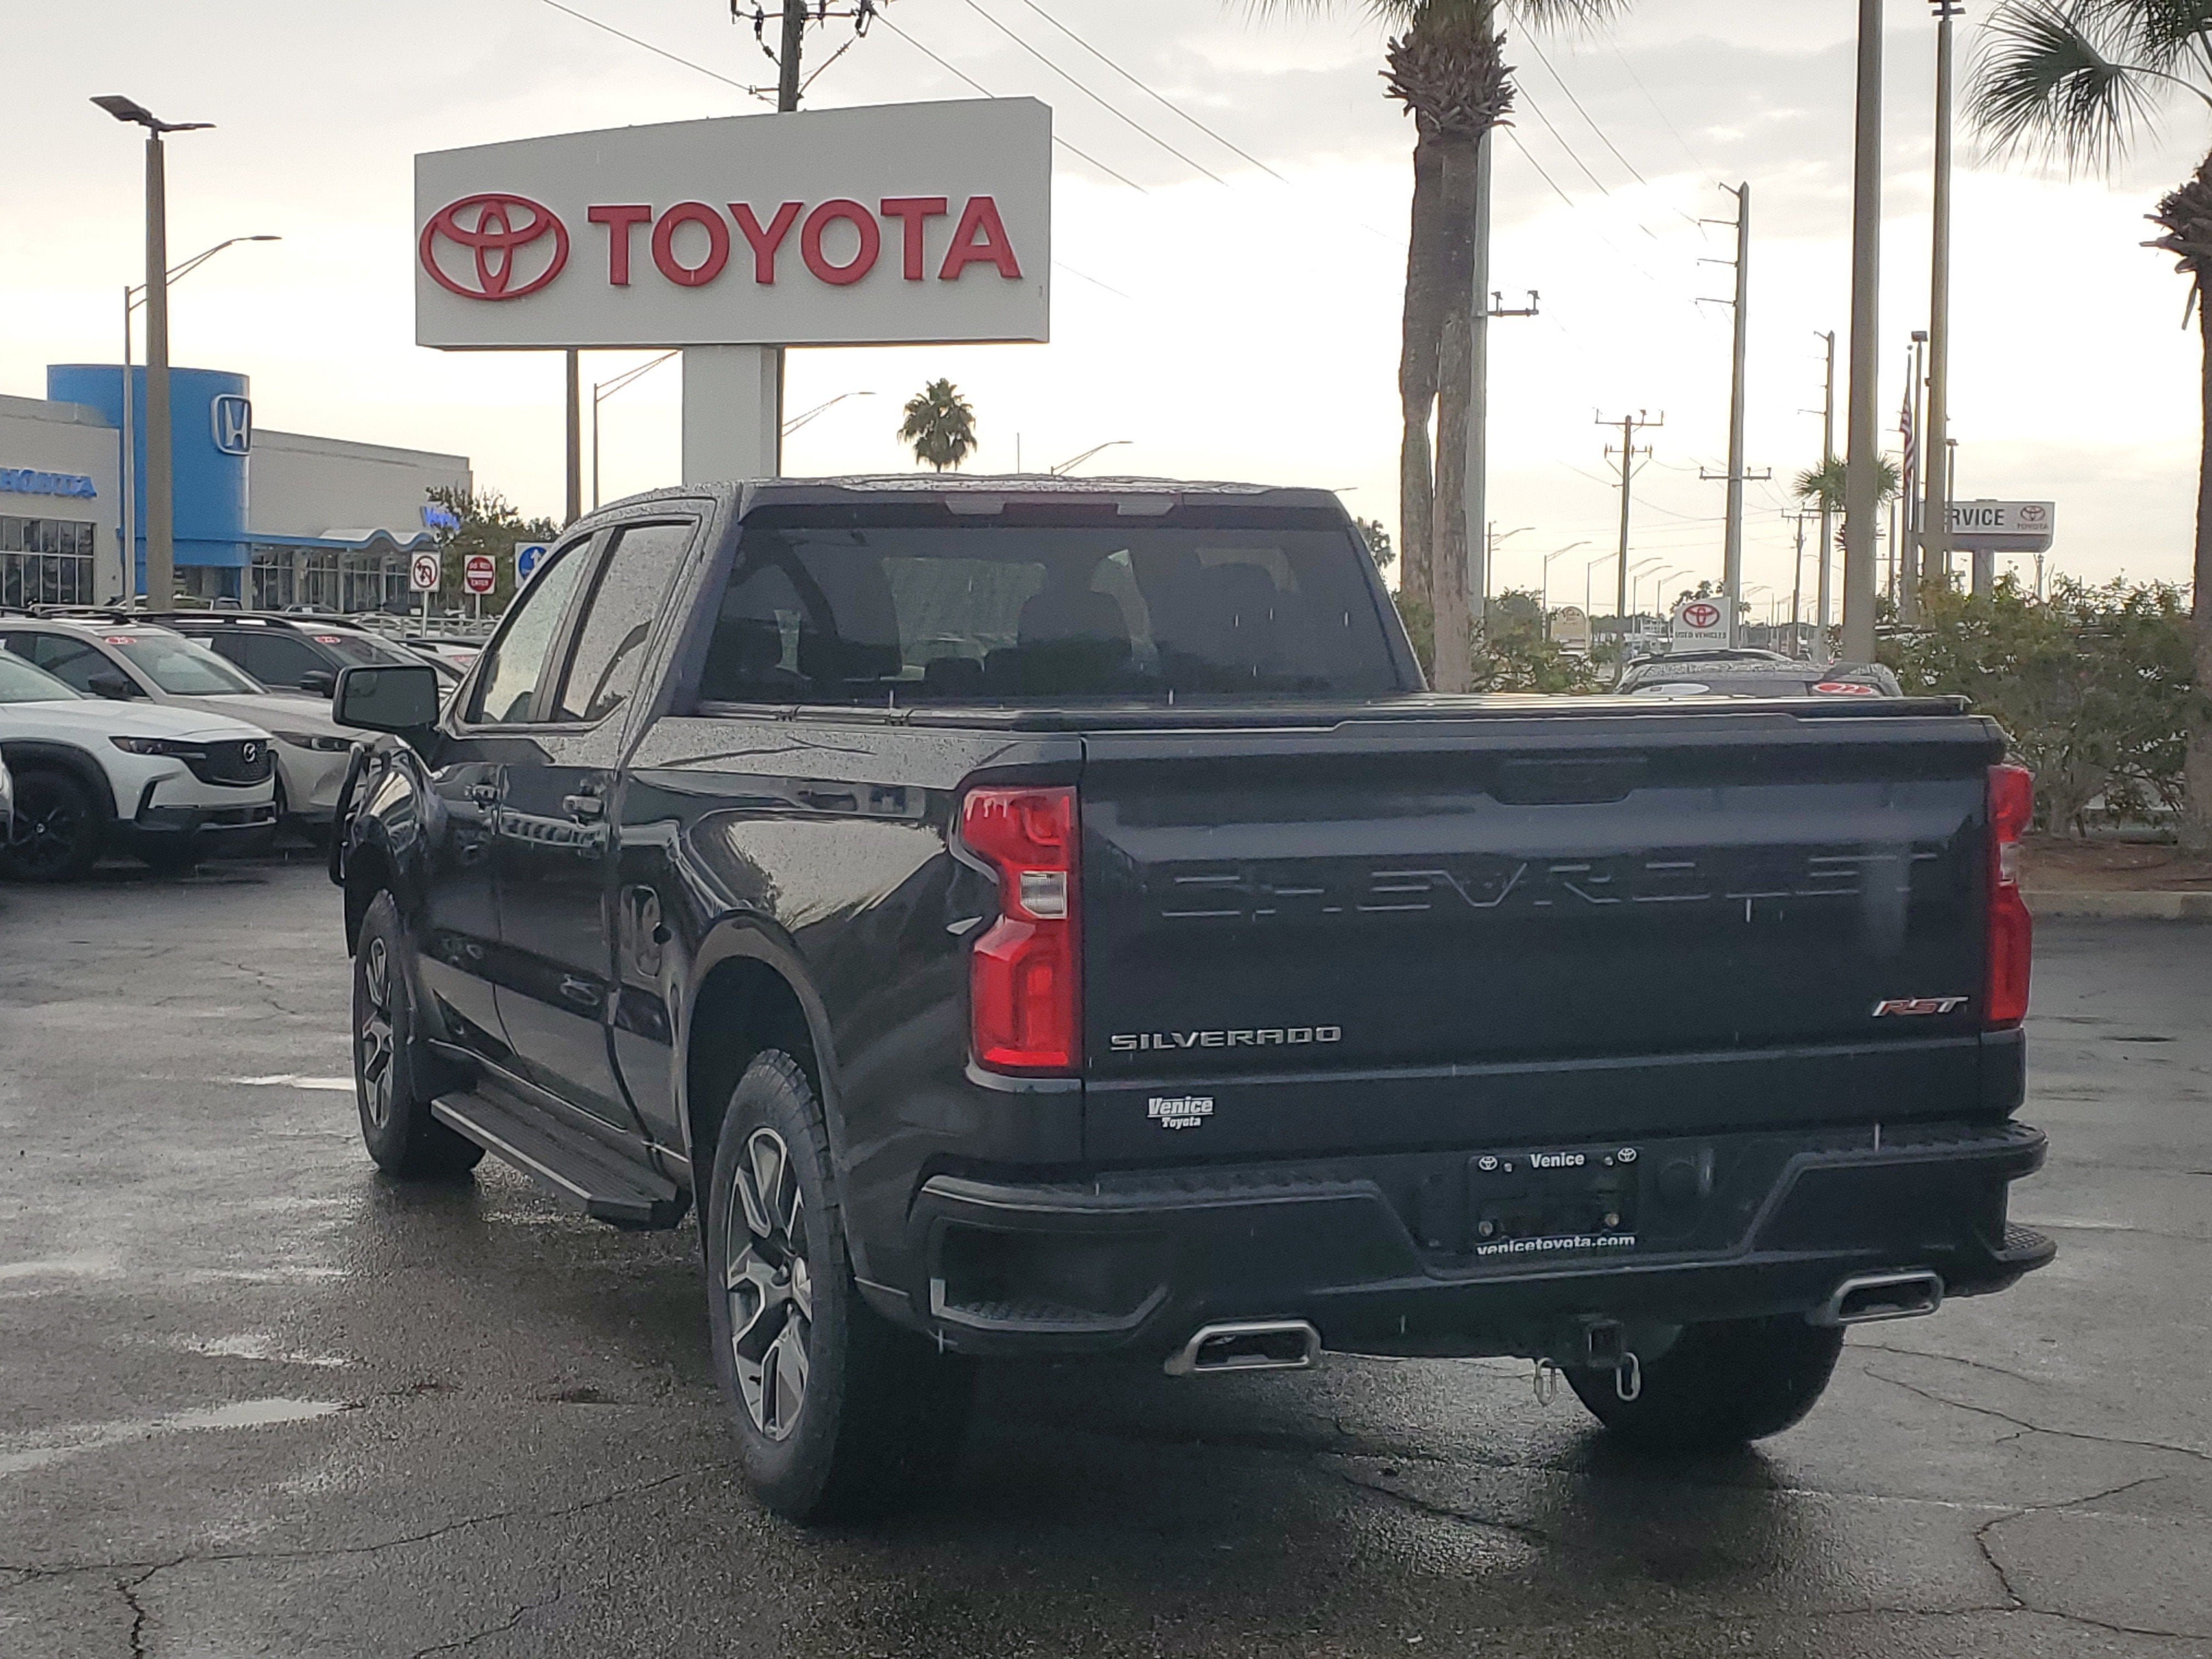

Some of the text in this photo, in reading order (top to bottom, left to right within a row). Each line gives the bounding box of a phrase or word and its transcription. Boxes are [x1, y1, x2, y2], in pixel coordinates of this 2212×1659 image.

[588, 196, 1022, 286] TOYOTA
[1952, 508, 2005, 526] RVICE
[1872, 996, 1969, 1017] RST
[1110, 1025, 1342, 1052] SILVERADO
[1148, 1096, 1214, 1115] Venice
[1161, 1116, 1201, 1130] Toyota
[1530, 1152, 1585, 1169] Venice
